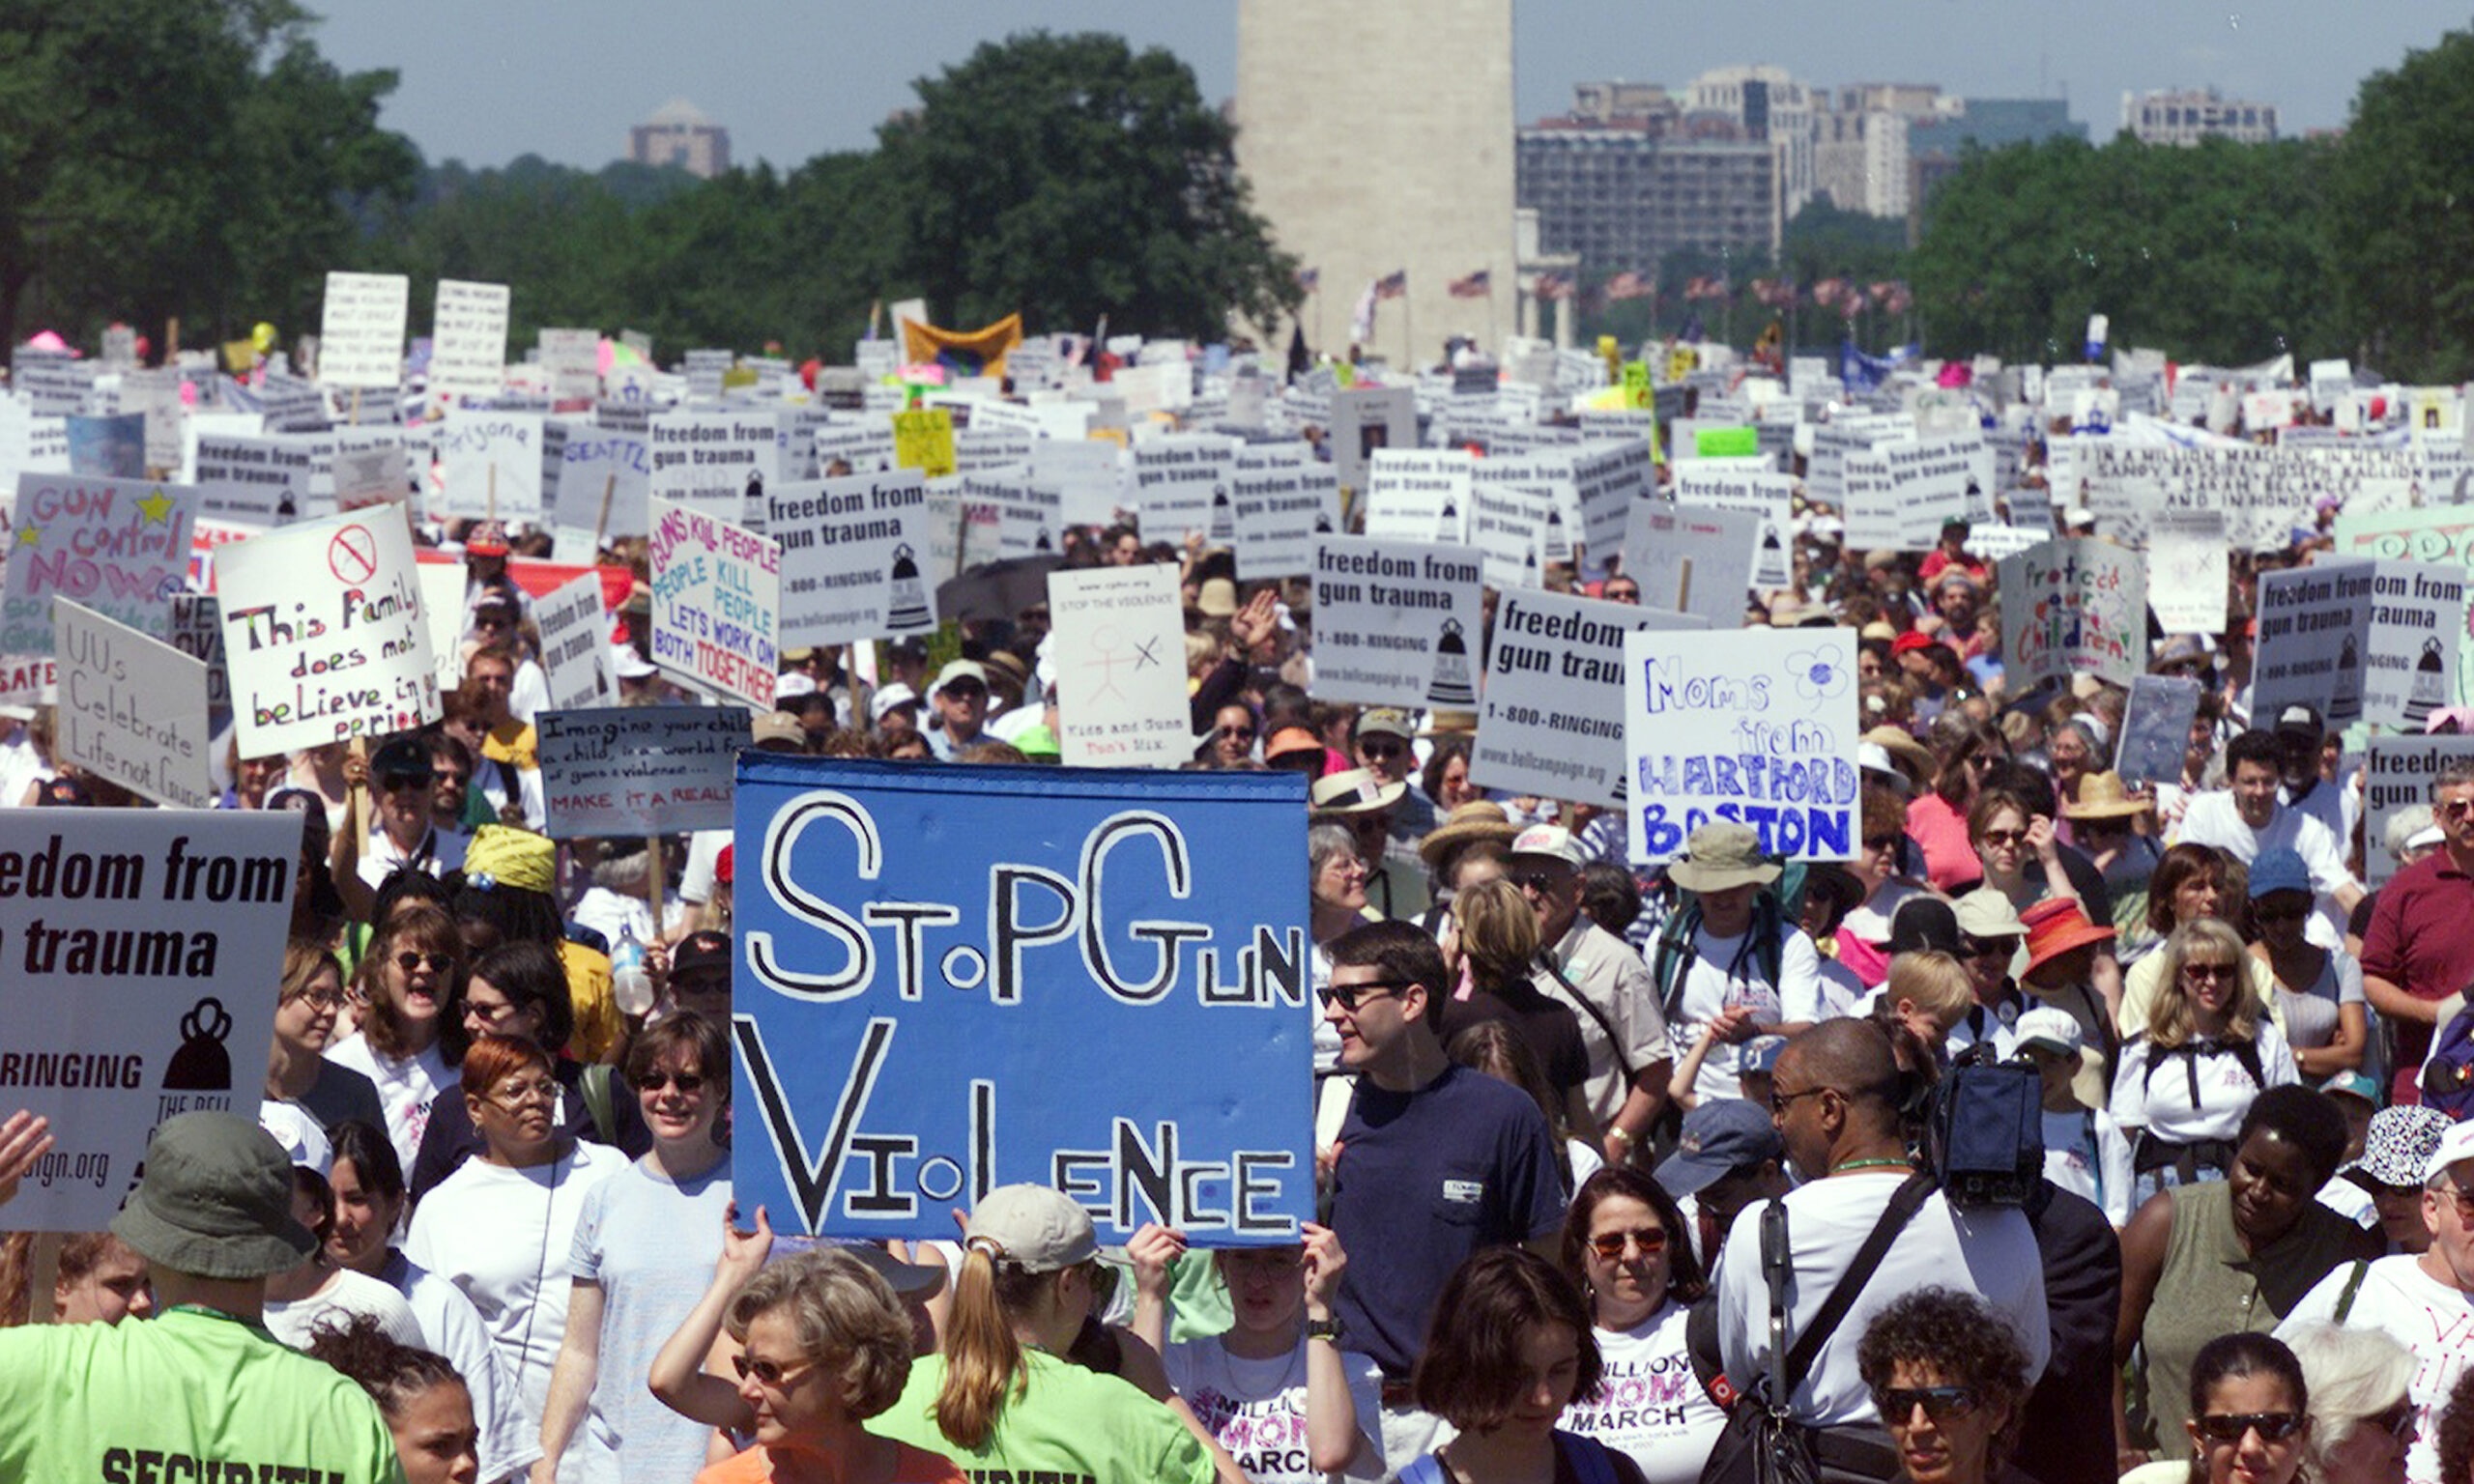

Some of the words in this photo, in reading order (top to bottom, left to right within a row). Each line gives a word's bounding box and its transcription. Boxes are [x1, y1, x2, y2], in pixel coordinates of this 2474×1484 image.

[652, 422, 729, 442] freedom
[734, 422, 775, 441] from
[198, 441, 267, 464] freedom
[653, 449, 687, 470] gun
[693, 448, 756, 465] trauma
[231, 467, 290, 485] trauma
[1682, 478, 1747, 497] freedom
[1752, 481, 1789, 499] from
[32, 486, 117, 523] GUN
[769, 491, 865, 522] freedom
[871, 485, 924, 514] from
[2167, 494, 2209, 507] AND
[648, 507, 689, 575] GUNS
[722, 525, 780, 576] PEOPLE
[773, 528, 815, 556] gun
[822, 518, 902, 546] trauma
[651, 556, 708, 609] PEOPLE
[717, 558, 754, 597] KILL
[1318, 546, 1416, 579] freedom
[1424, 555, 1480, 583] from
[1059, 601, 1090, 613] STOP
[1093, 597, 1113, 609] THE
[1117, 592, 1175, 608] VIOLENCE
[1318, 581, 1362, 607] gun
[1369, 584, 1453, 610] trauma
[2264, 580, 2331, 608] freedom
[2336, 573, 2372, 599] from
[2414, 572, 2462, 602] from
[227, 602, 327, 651] This
[342, 571, 420, 631] Family
[714, 585, 772, 638] PEOPLE
[1504, 598, 1625, 649] freedom
[2261, 616, 2292, 643] gun
[2297, 609, 2352, 633] trauma
[713, 618, 753, 656] WORK
[757, 638, 776, 669] ON
[1497, 643, 1552, 674] gun
[291, 649, 366, 678] does
[653, 629, 694, 667] BOTH
[697, 639, 774, 713] TOGETHER
[394, 676, 418, 699] in
[1644, 655, 1772, 714] Moms
[71, 669, 193, 759] Celebrate
[542, 716, 653, 746] Imagine
[663, 718, 705, 737] your
[71, 716, 117, 771] Life
[121, 757, 154, 789] not
[661, 740, 716, 756] world
[1730, 715, 1836, 755] from
[1637, 754, 1857, 806] HARTFORD
[2370, 784, 2418, 811] gun
[551, 792, 616, 812] MAKE
[649, 791, 668, 806] A
[670, 786, 734, 802] REALI
[162, 835, 288, 903] from
[1079, 810, 1306, 1008] GUN
[25, 918, 219, 977] trauma
[0, 1052, 144, 1090] RINGING
[731, 1013, 1298, 1238] VIOLENCE
[1603, 1355, 1689, 1378] ILLION
[1569, 1404, 1687, 1433] MARCH
